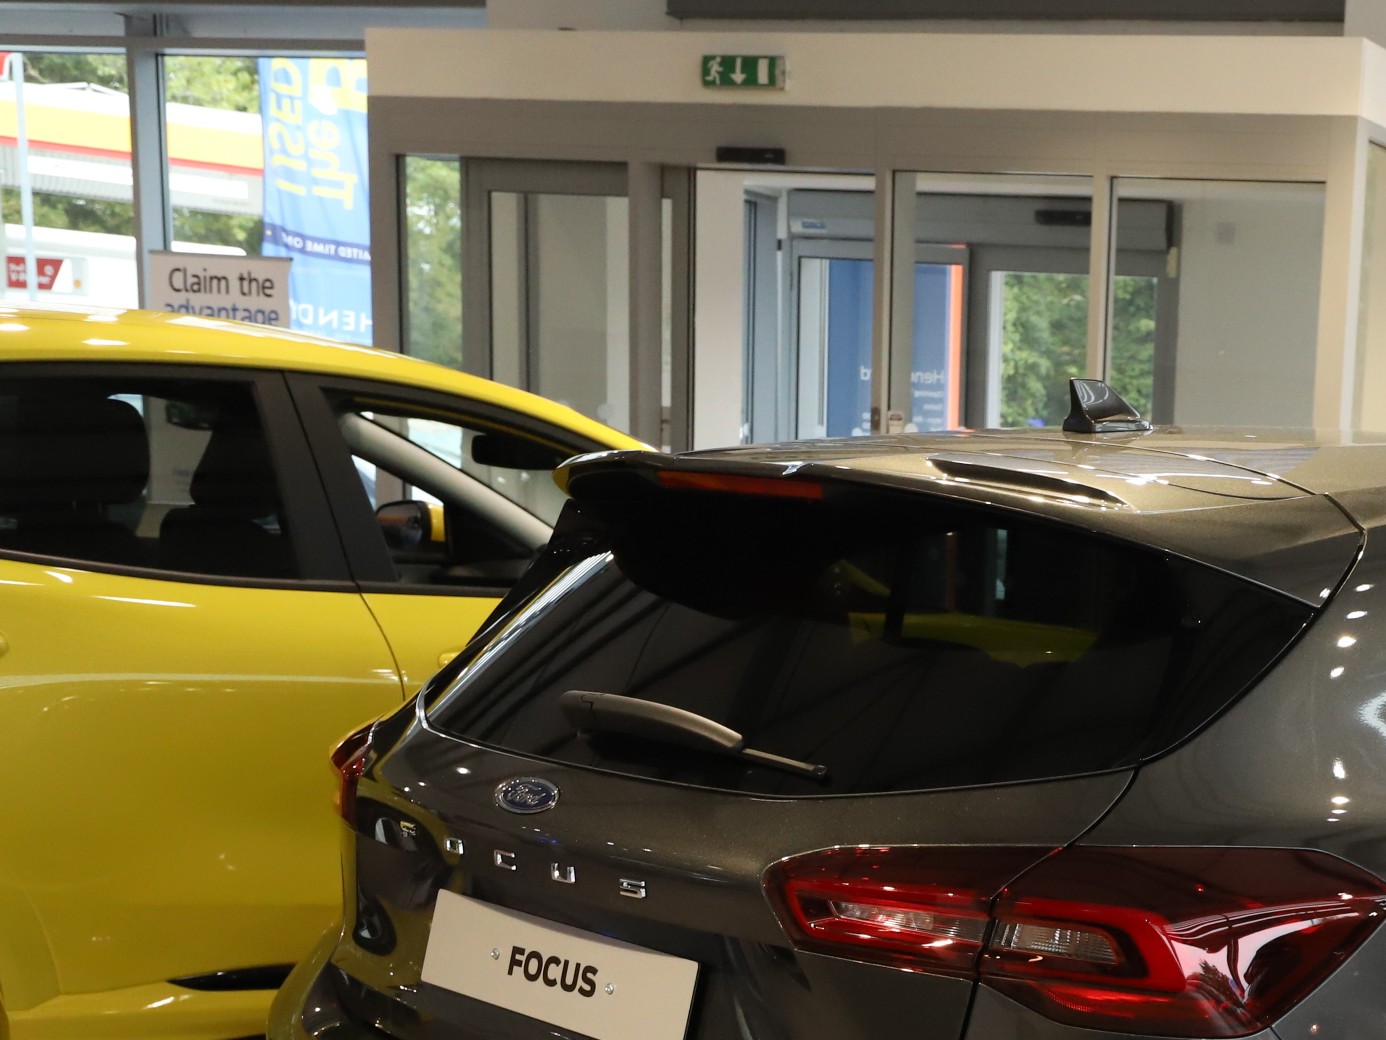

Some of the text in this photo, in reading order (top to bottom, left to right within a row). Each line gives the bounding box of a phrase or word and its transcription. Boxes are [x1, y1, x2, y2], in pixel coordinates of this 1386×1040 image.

[168, 267, 275, 298] Claim the
[507, 945, 599, 998] FOCUS
